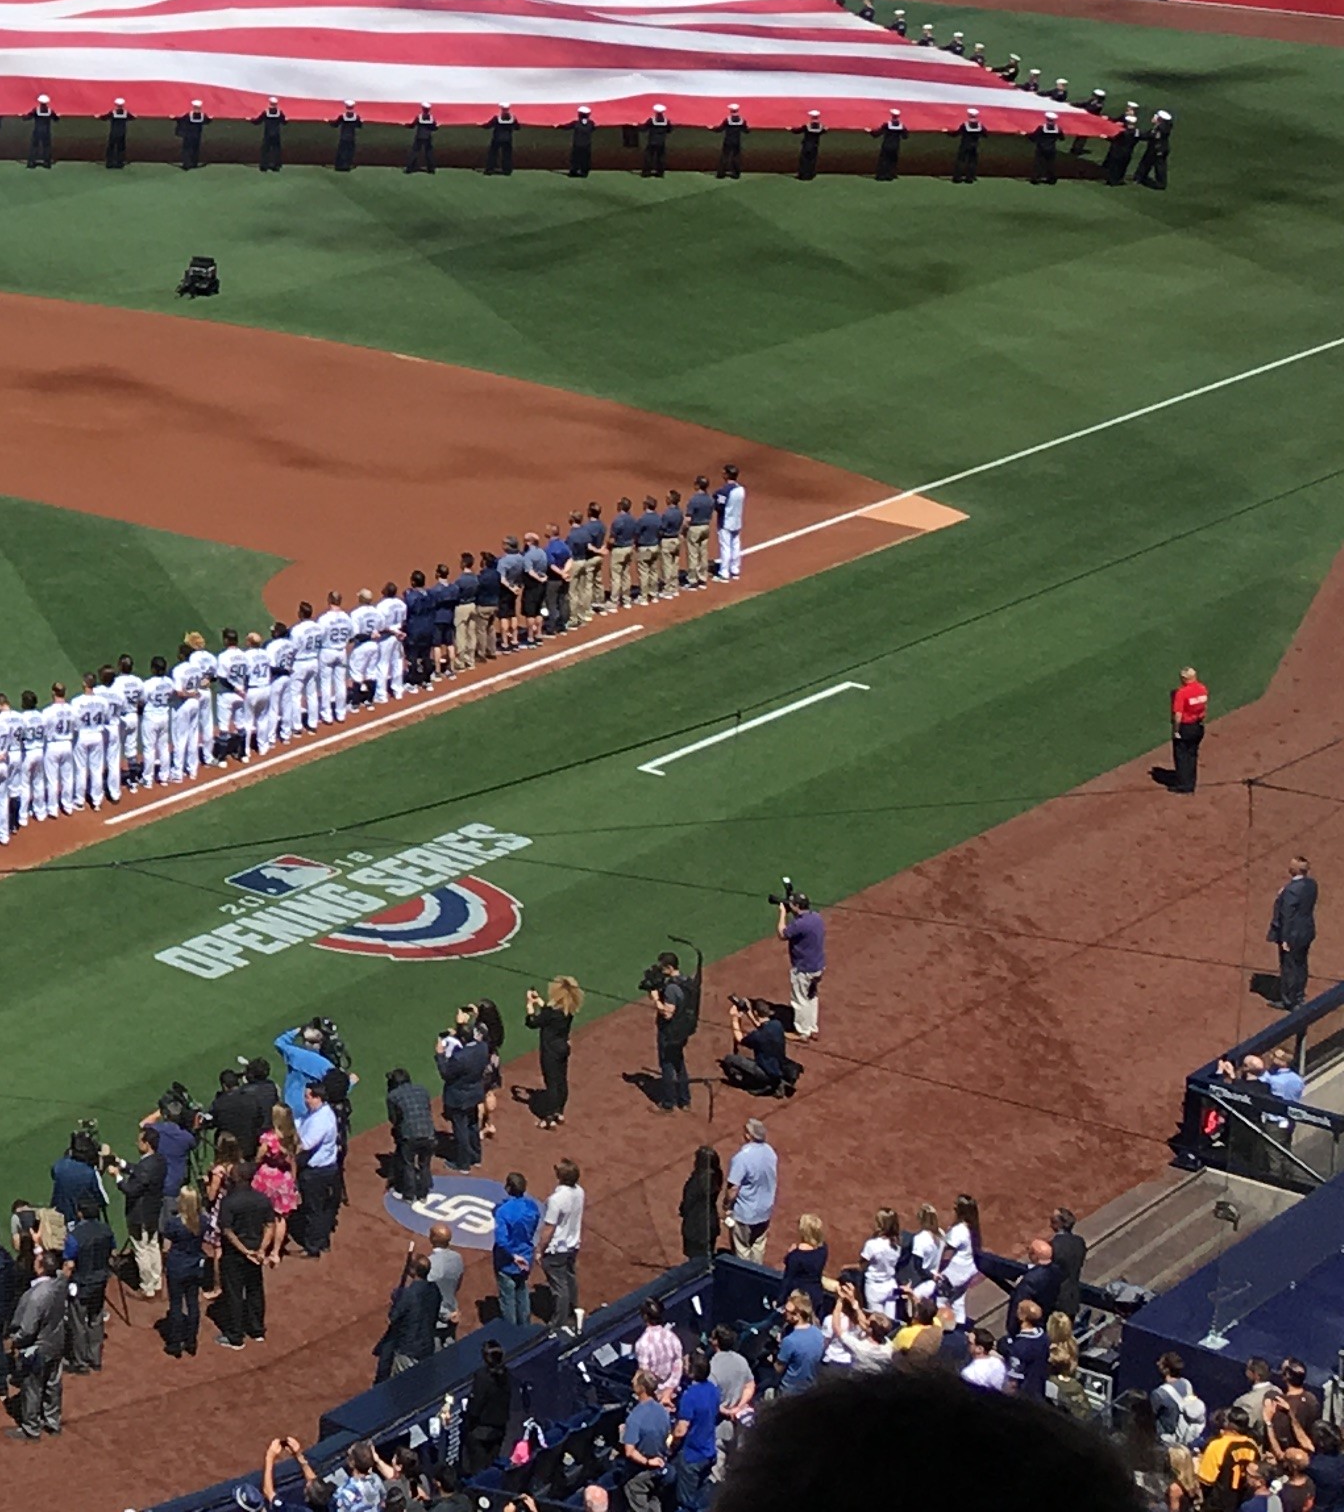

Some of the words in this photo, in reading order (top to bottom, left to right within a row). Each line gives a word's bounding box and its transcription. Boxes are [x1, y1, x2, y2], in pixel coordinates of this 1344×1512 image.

[55, 718, 72, 734] 41
[80, 710, 103, 726] 44
[153, 881, 388, 980] OPENING
[346, 821, 534, 898] SERIES
